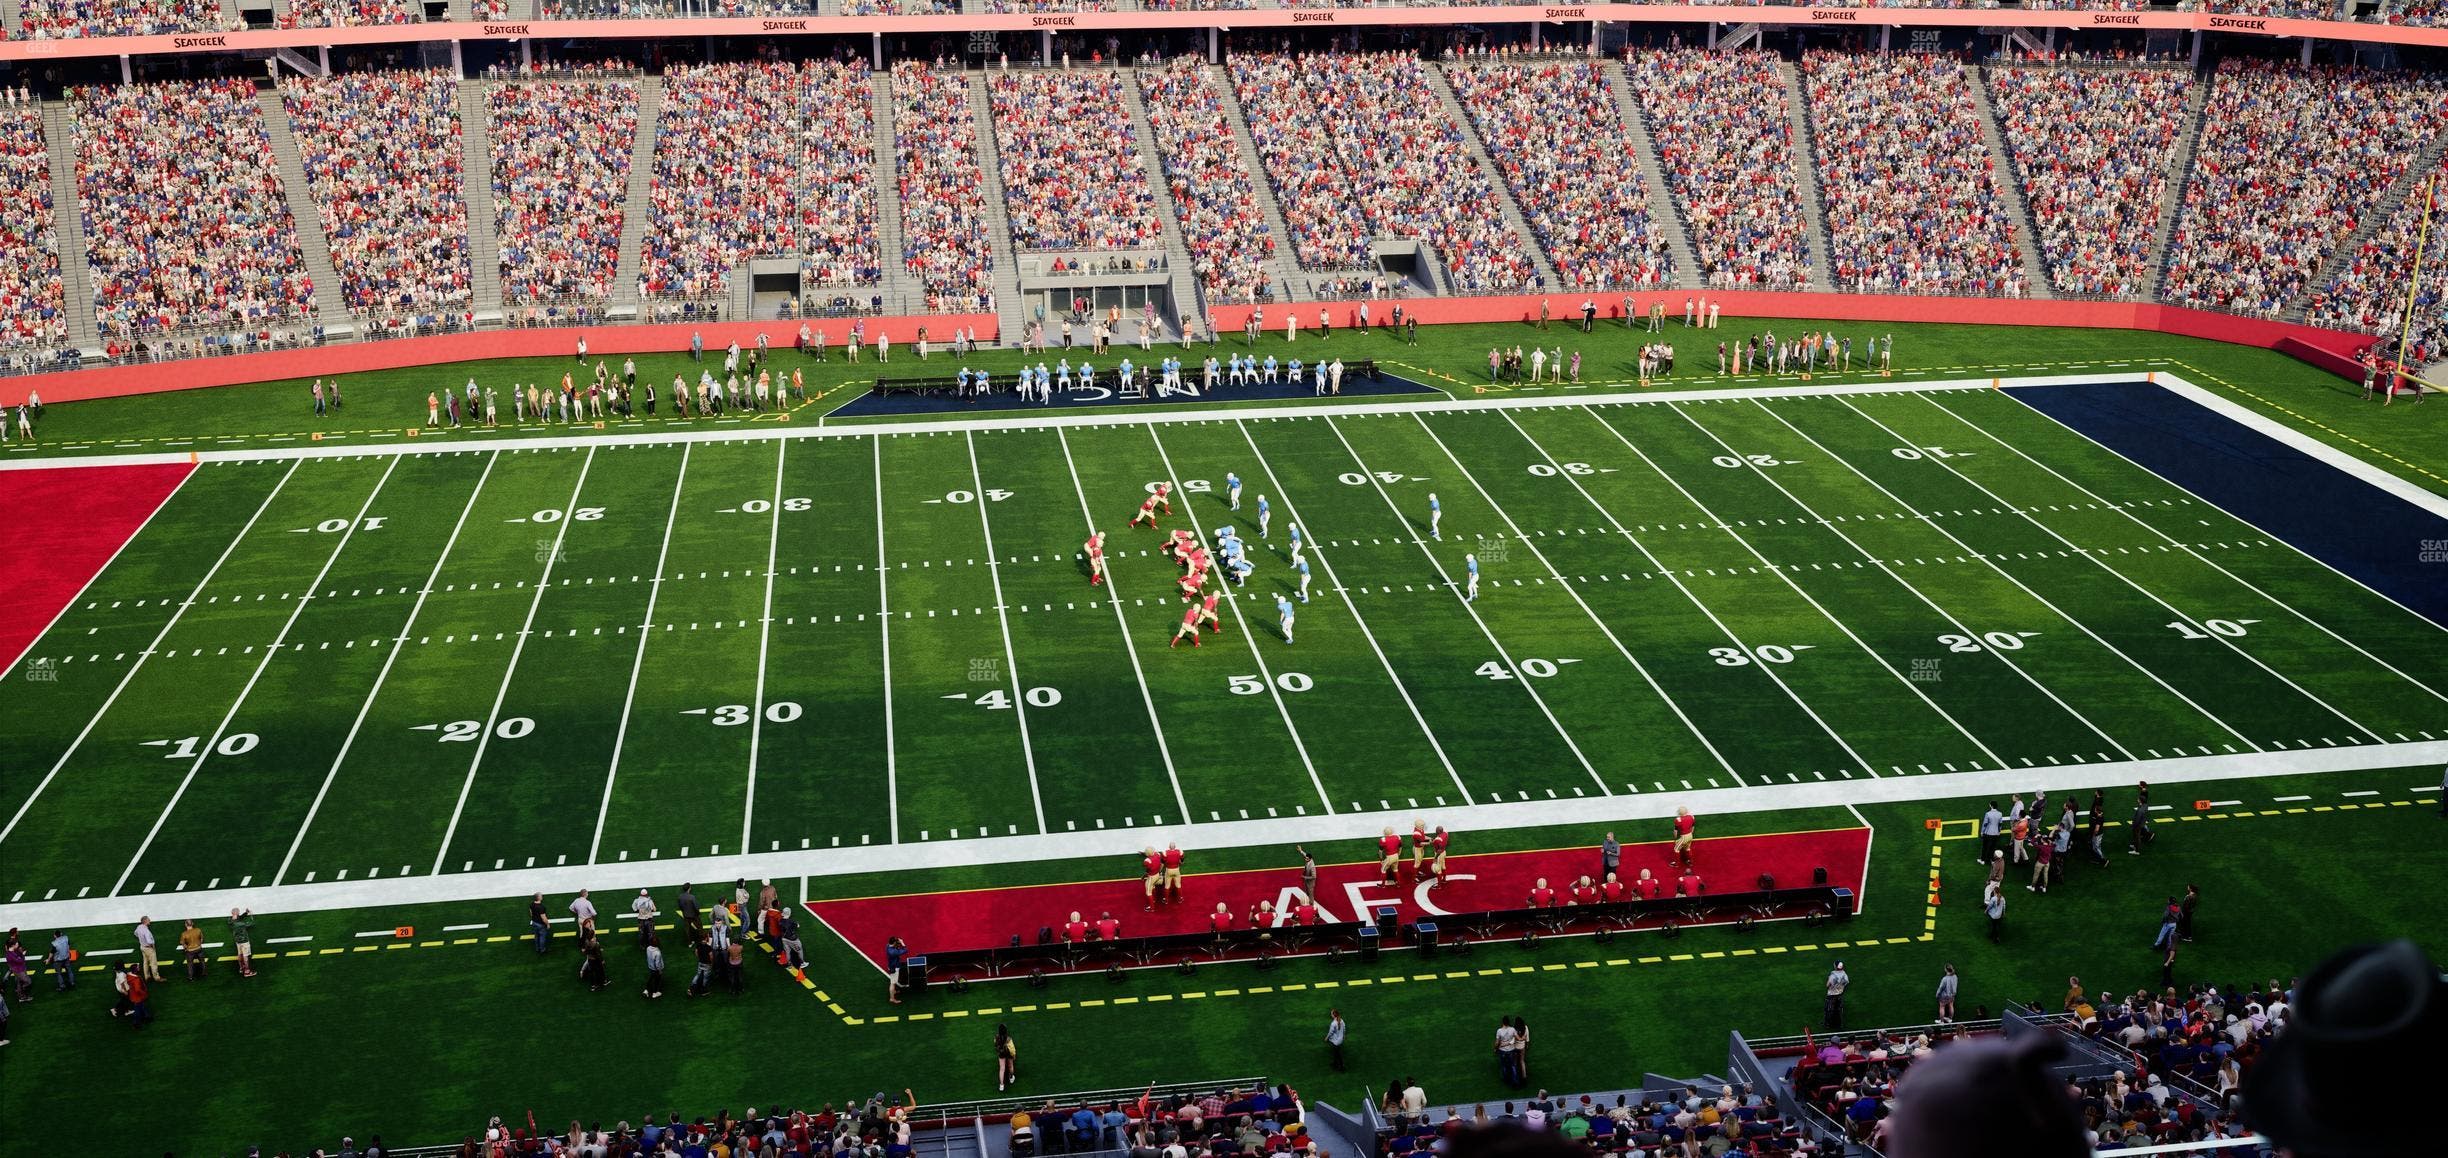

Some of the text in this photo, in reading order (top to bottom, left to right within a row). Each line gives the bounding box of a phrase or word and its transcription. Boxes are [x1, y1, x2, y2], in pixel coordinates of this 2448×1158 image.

[1293, 12, 1335, 22] SEATGEEK
[1545, 8, 1585, 18] SEATGEEK
[1812, 10, 1856, 21] SEATGEEK
[2093, 14, 2140, 24] SEATGEEK
[762, 20, 807, 30] SEATGEEK
[1032, 16, 1075, 26] SEATGEEK
[2209, 16, 2266, 30] SEATGEEK
[484, 24, 529, 35] SEATGEEK
[174, 36, 226, 48] SEATGEEK
[1712, 454, 1780, 469] 20
[1527, 462, 1595, 477] 30
[1337, 471, 1403, 486] 40
[945, 489, 1014, 504] 40
[741, 497, 812, 513] 30
[532, 507, 606, 523] 20
[2165, 618, 2248, 640] 10
[1937, 631, 2024, 653] 20
[1708, 644, 1795, 666] 30
[1474, 657, 1558, 680] 40
[1227, 672, 1314, 695] 50
[974, 686, 1062, 710] 40
[711, 701, 803, 726] 30
[438, 717, 536, 742] 20
[164, 733, 260, 759] 10
[1271, 874, 1477, 929] AFC
[400, 928, 409, 936] 20
